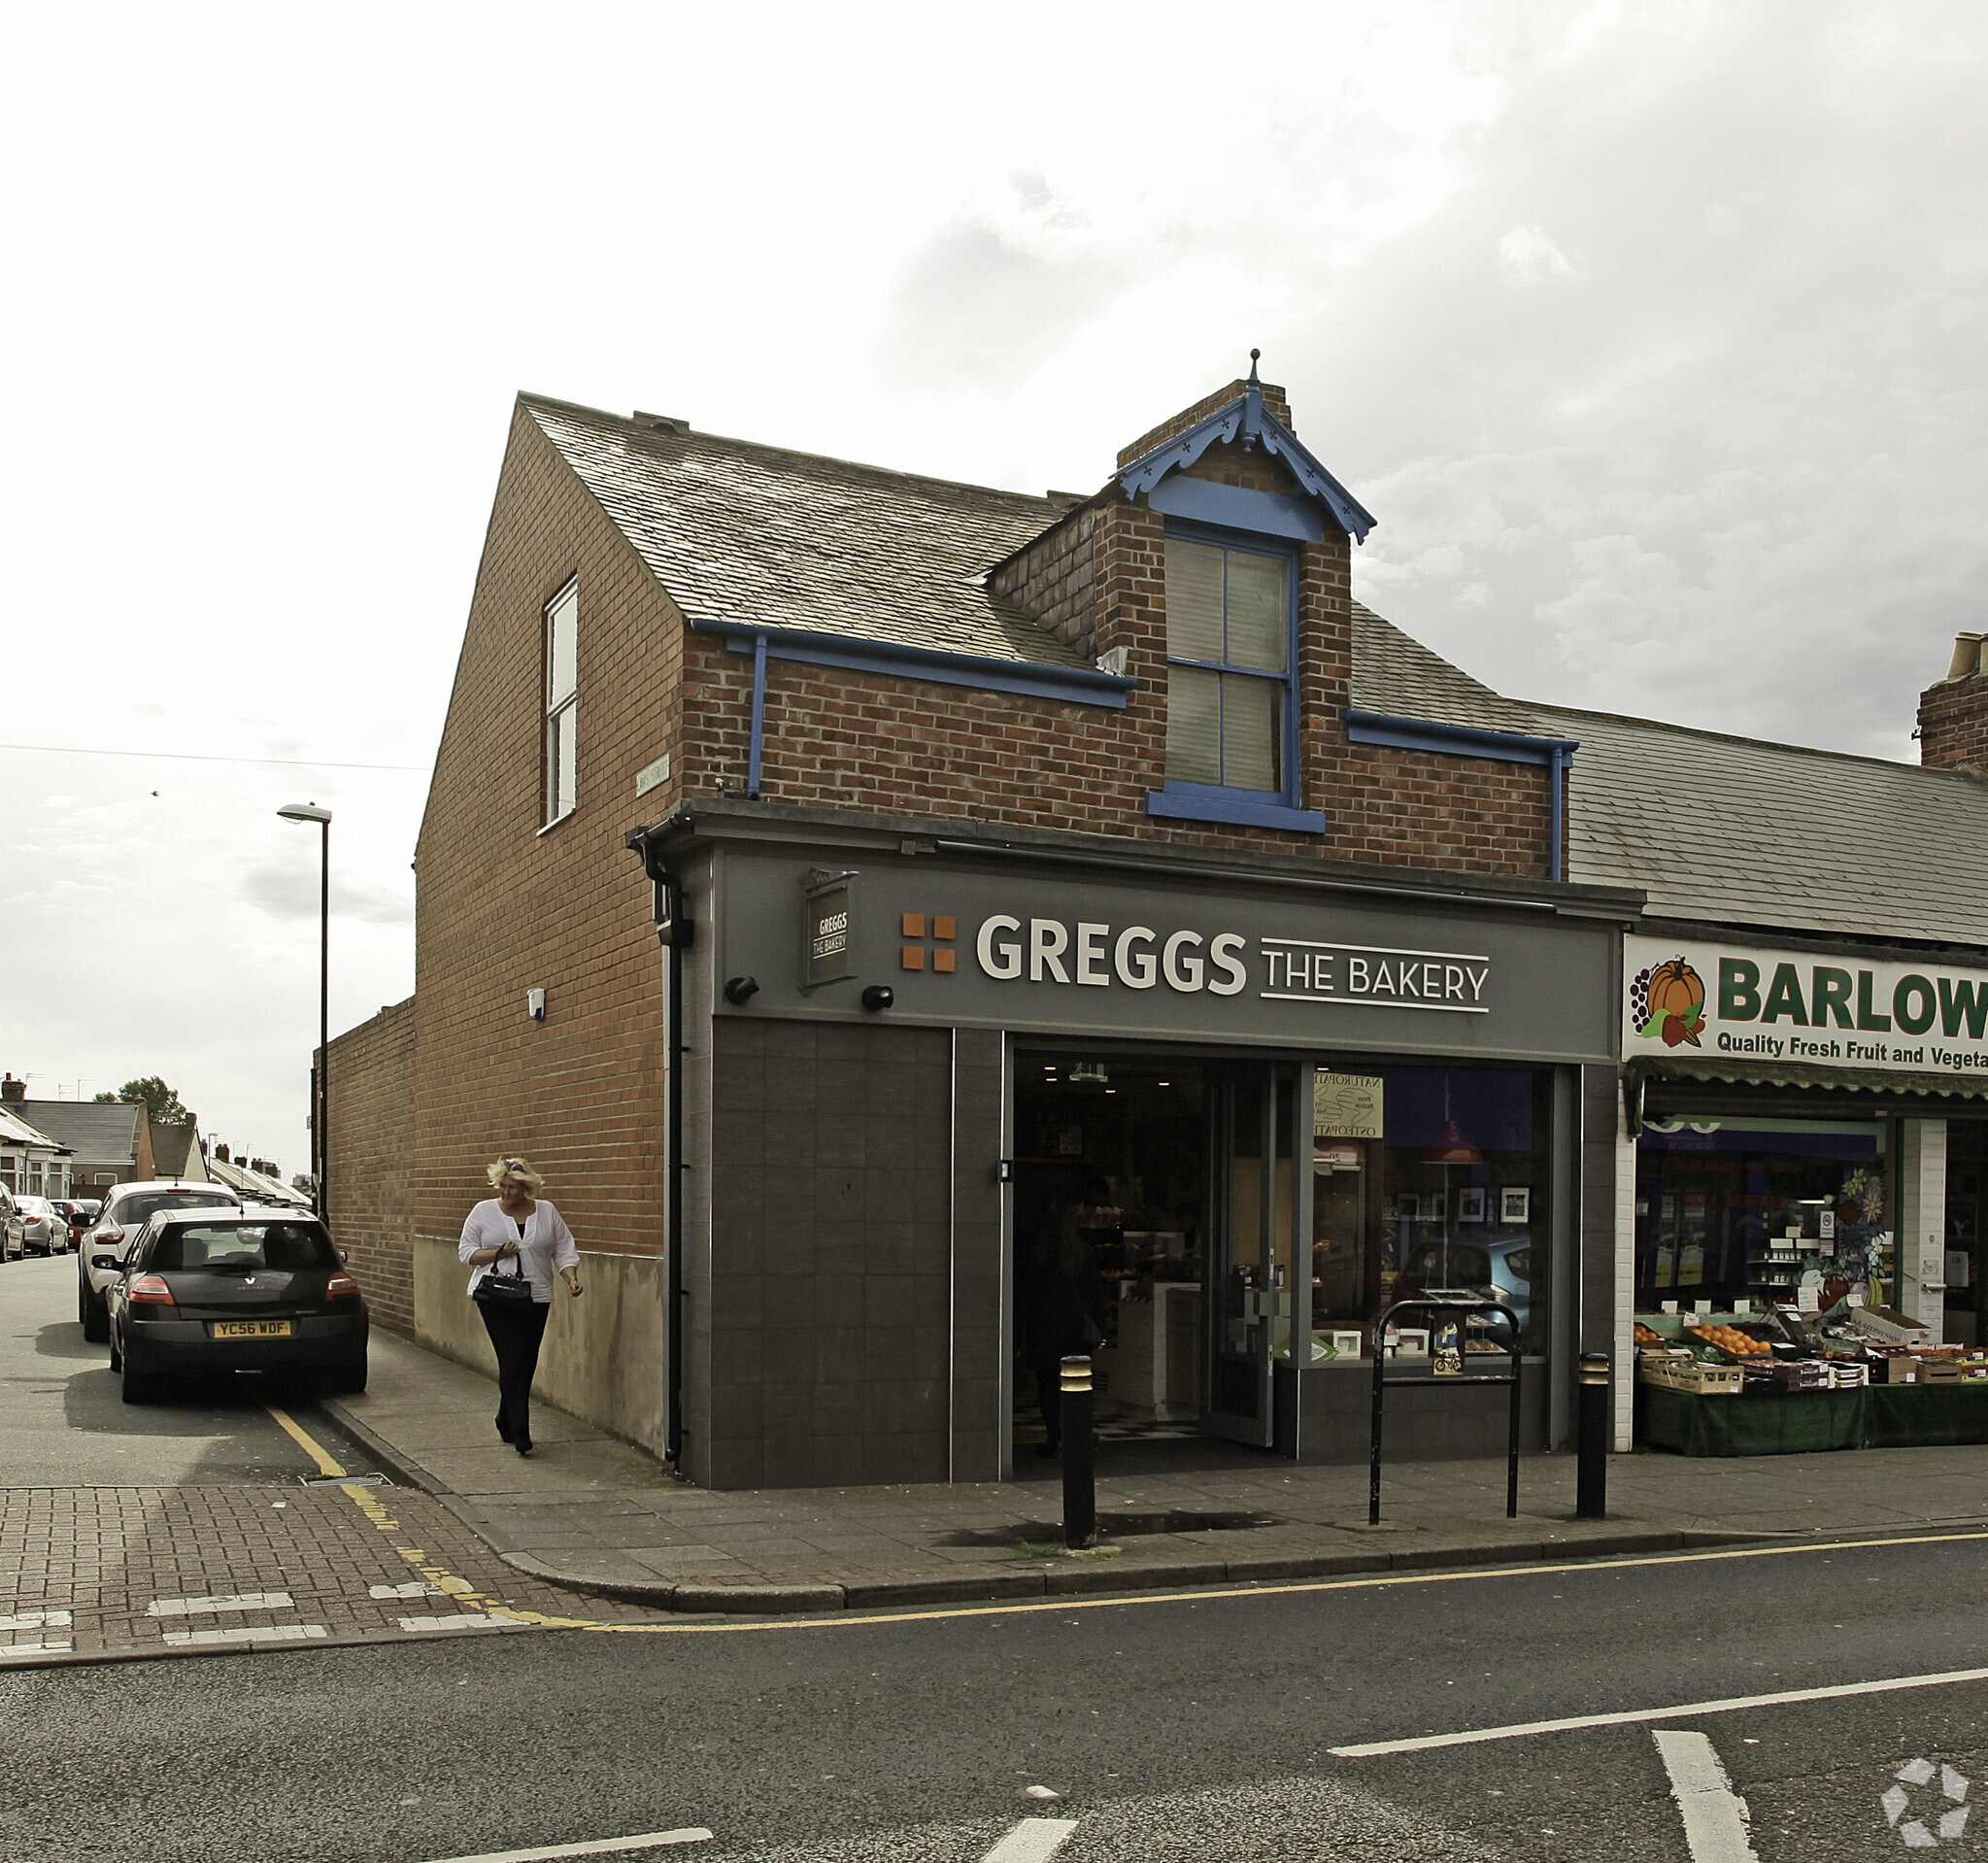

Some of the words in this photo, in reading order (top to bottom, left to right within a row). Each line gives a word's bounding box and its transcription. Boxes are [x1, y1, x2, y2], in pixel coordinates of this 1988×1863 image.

[820, 913, 847, 934] GREGGS
[814, 942, 824, 954] THE
[825, 935, 846, 952] BAKERY
[976, 914, 1247, 997] GREGGS
[1261, 950, 1334, 991] THE
[1349, 957, 1489, 1001] BAKERY
[1717, 956, 1988, 1040] BARLOW
[1717, 1032, 1784, 1058] Quality
[1790, 1036, 1840, 1058] Fresh
[1846, 1040, 1887, 1061] Fruit
[1892, 1046, 1923, 1064] and
[220, 1323, 255, 1336] YC56
[259, 1322, 286, 1335] WDF
